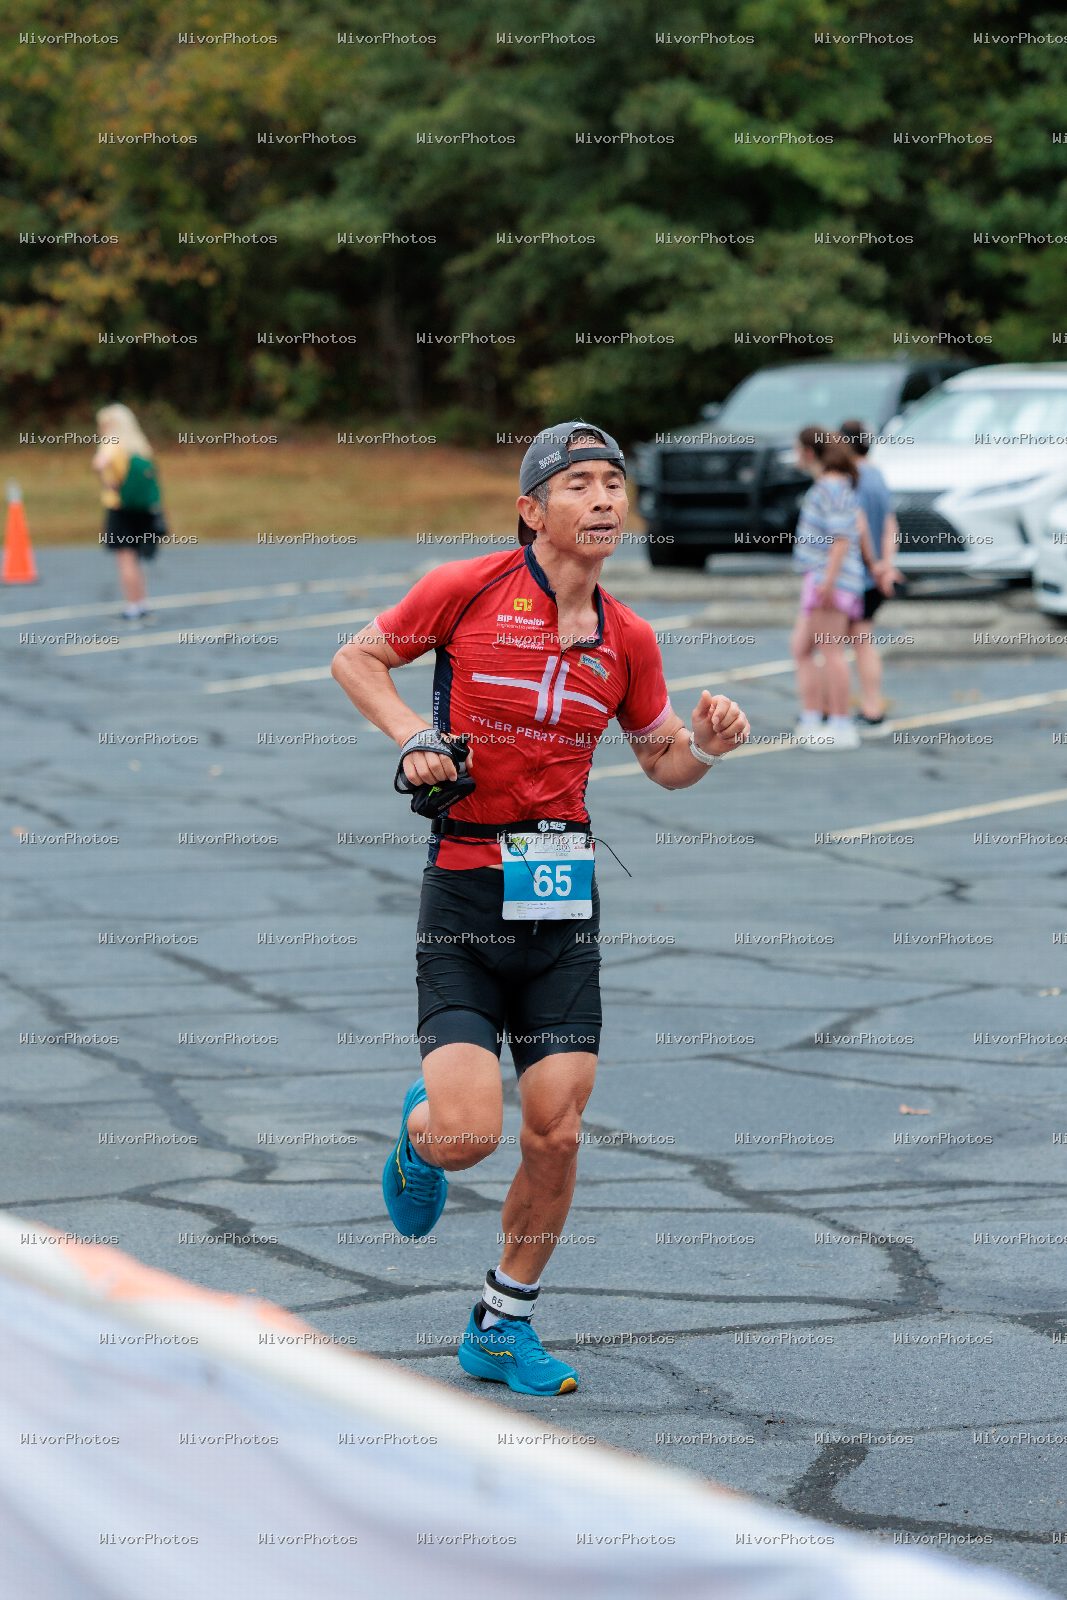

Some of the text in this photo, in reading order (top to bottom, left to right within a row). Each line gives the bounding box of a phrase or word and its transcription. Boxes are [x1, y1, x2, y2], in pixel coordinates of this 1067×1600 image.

[496, 614, 545, 627] BIP Wealth
[470, 714, 513, 733] TYLER
[516, 726, 558, 743] PERRY
[533, 864, 573, 898] 65
[491, 1295, 504, 1308] 65
